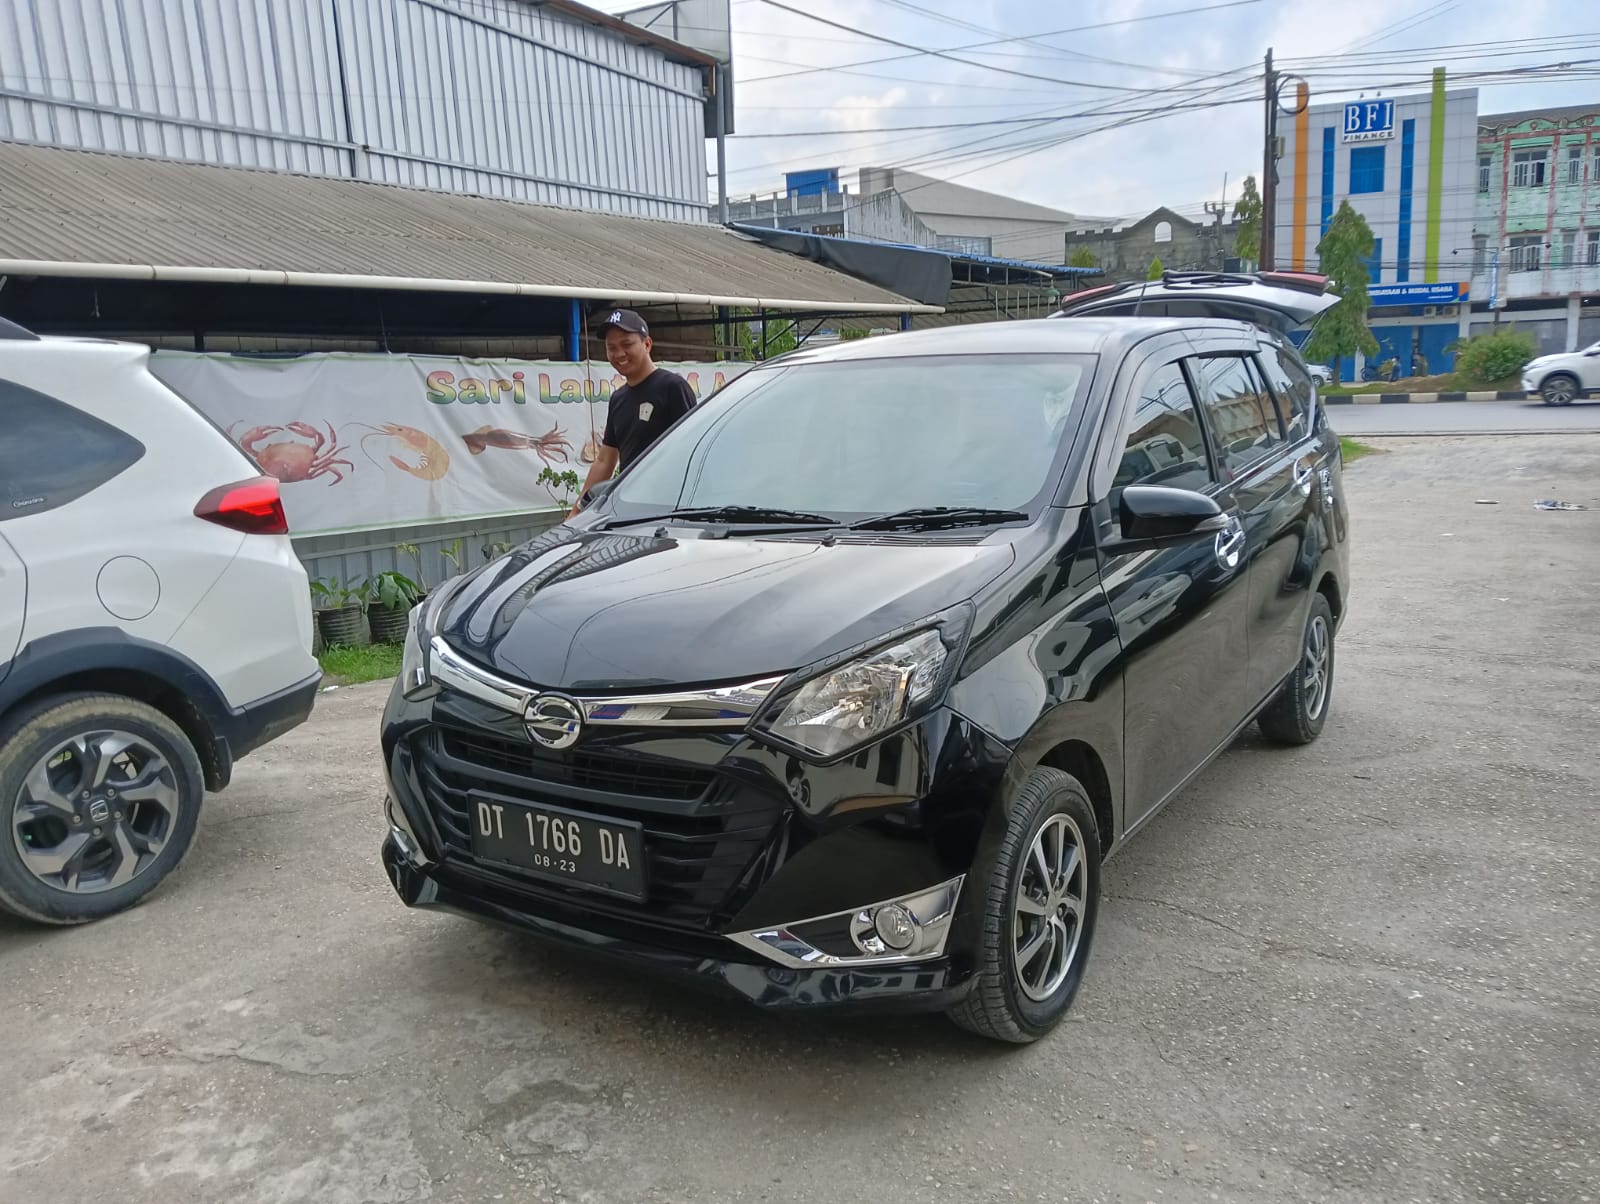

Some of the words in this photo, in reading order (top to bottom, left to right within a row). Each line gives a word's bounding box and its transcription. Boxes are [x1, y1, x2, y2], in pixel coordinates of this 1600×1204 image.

[1346, 102, 1392, 132] BFI
[1344, 131, 1393, 142] FINANCE
[426, 370, 526, 405] Sari
[478, 801, 503, 839] DT
[525, 812, 582, 856] 1766
[599, 828, 630, 870] DA
